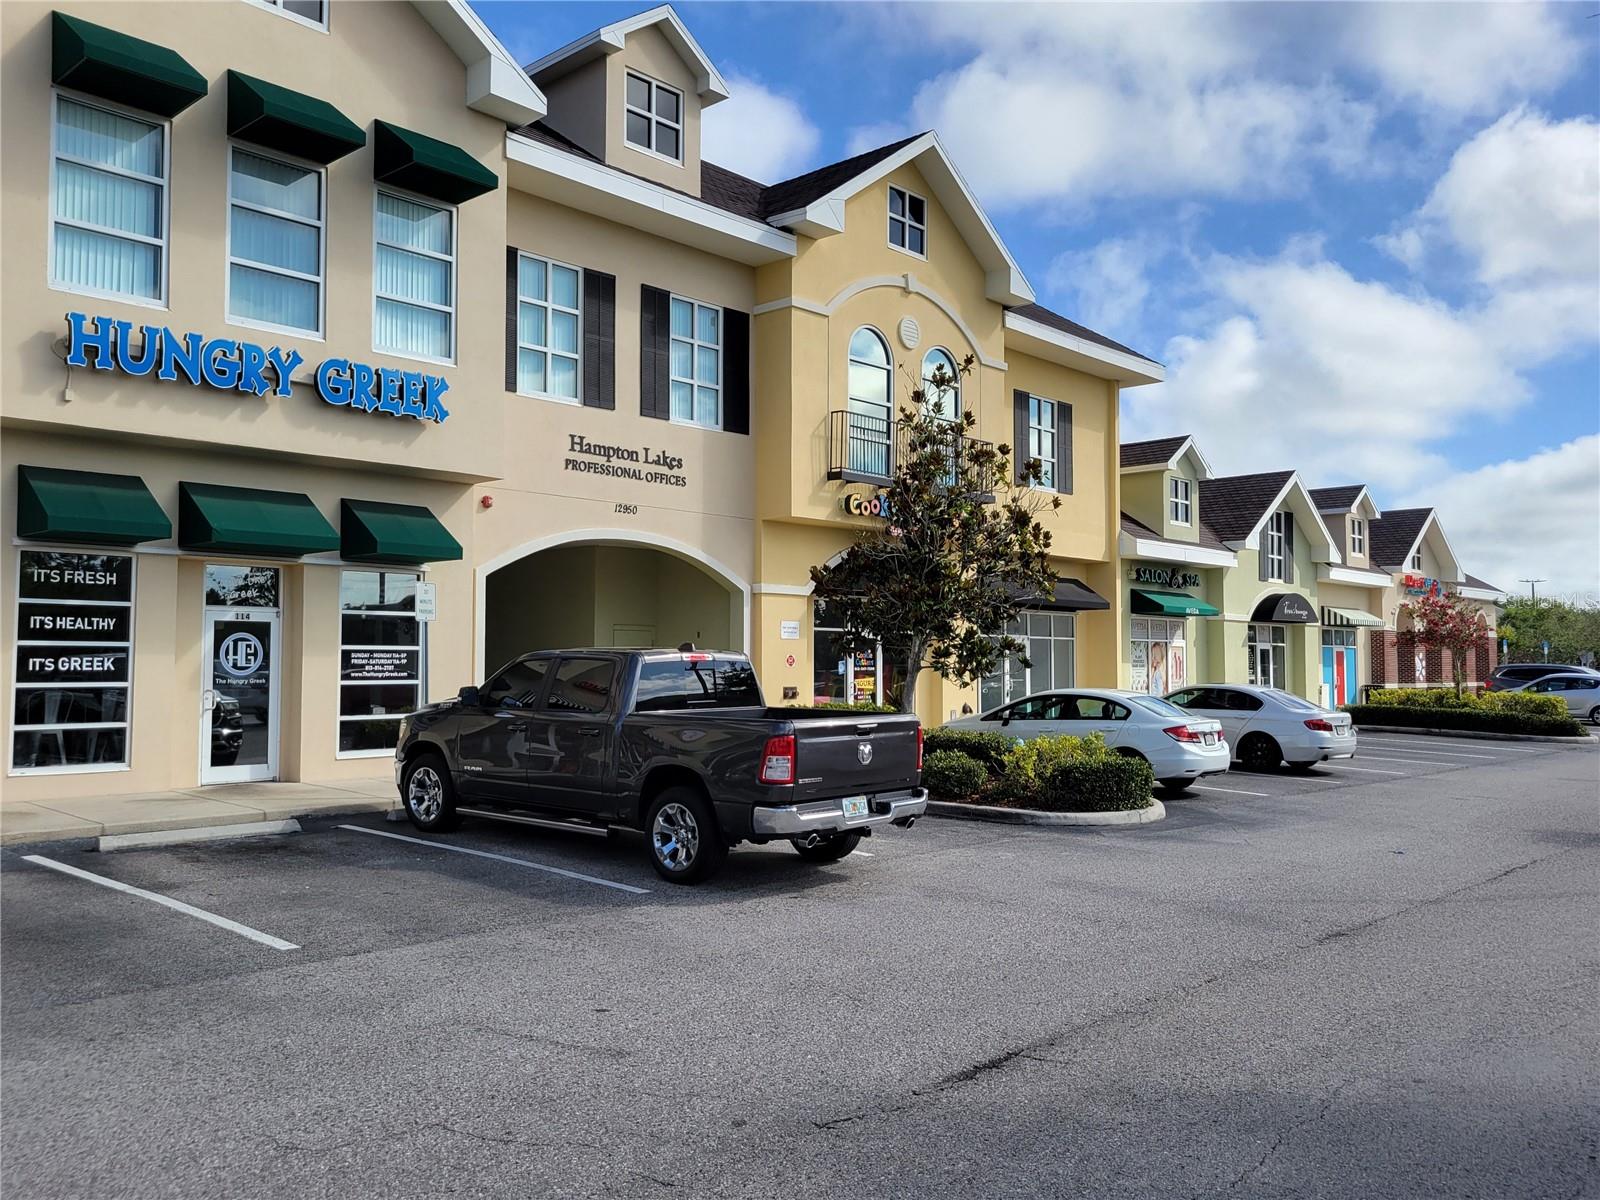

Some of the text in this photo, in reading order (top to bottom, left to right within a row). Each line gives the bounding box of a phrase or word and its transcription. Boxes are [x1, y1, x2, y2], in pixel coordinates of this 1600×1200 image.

[65, 311, 450, 424] HUNGRY GREEK
[568, 433, 683, 470] Hampton Lakes
[564, 458, 687, 487] PROFESSIONAL OFFICES
[614, 503, 638, 515] 12950
[33, 569, 117, 585] IT'S FRESH
[1140, 567, 1171, 584] SALON
[1186, 574, 1200, 587] SPA
[30, 616, 116, 630] IT'S HEALTHY
[28, 657, 115, 671] IT'S GREEK
[228, 679, 248, 687] Hungry
